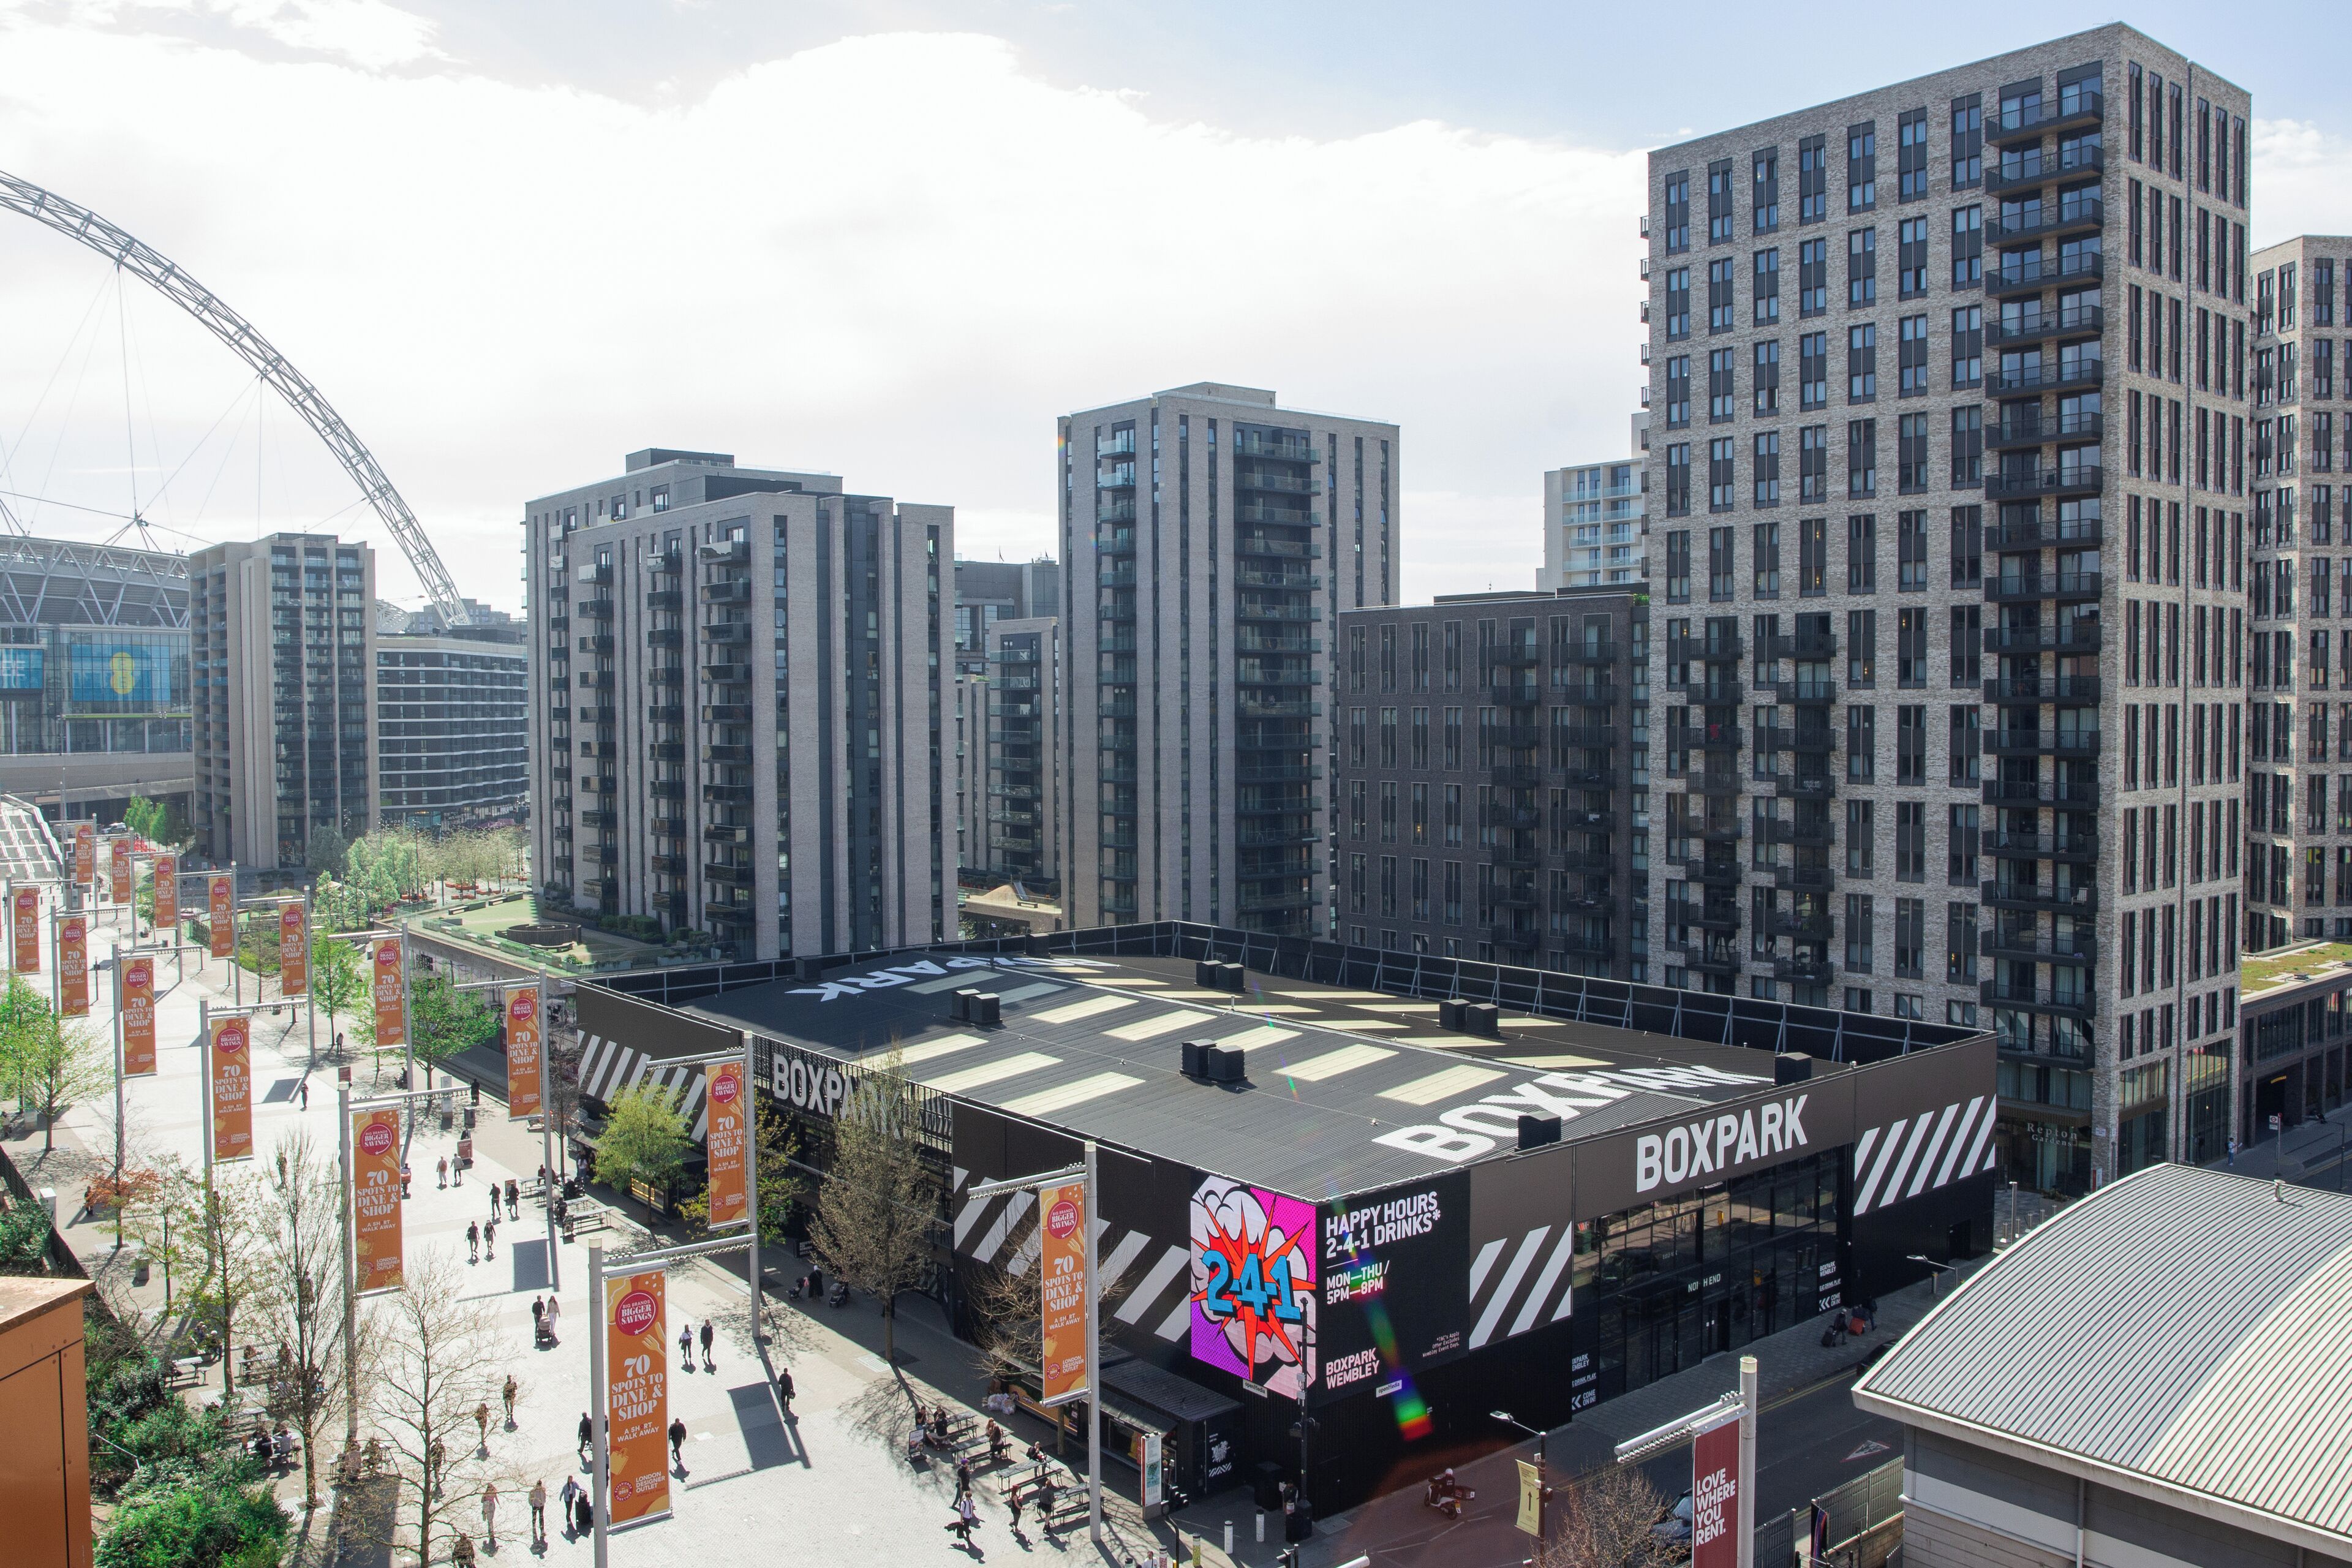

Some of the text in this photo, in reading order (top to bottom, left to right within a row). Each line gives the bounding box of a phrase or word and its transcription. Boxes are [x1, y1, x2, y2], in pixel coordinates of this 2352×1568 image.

[67, 951, 80, 959] 70
[382, 975, 394, 984] 70
[516, 1031, 530, 1042] 70
[510, 1049, 529, 1057] DINE
[513, 1055, 534, 1064] SHOP
[223, 1065, 240, 1077] 70
[216, 1084, 238, 1093] DINE
[219, 1091, 245, 1101] SHOP
[718, 1116, 734, 1131] 70
[710, 1131, 731, 1140] SPOTS
[2026, 1123, 2077, 1139] Repton
[710, 1136, 742, 1149] DINE &
[1637, 1094, 1808, 1193] BOXPARK
[2032, 1134, 2073, 1147] Gardens
[714, 1146, 739, 1158] SHOP
[367, 1170, 388, 1186] 70
[357, 1186, 385, 1196] SPOTS
[358, 1193, 398, 1207] DINE &
[363, 1204, 394, 1216] SHOP
[1326, 1191, 1438, 1238] HAPPY HOURS
[1052, 1212, 1074, 1223] BIGGER
[1052, 1219, 1075, 1229] SAVINGS
[1326, 1229, 1370, 1259] 2-4-1
[1054, 1256, 1074, 1275] 70
[1819, 1261, 1835, 1272] BOXPARK
[1819, 1266, 1836, 1277] WEMBLEY
[1046, 1271, 1083, 1288] SPOTS TO
[1202, 1250, 1301, 1320] 2-4-1
[1688, 1273, 1721, 1292] NOH END
[1046, 1281, 1083, 1300] DINE &
[1050, 1294, 1079, 1311] SHOP
[622, 1304, 651, 1317] BIGGER
[622, 1312, 652, 1324] SAVINGS
[1422, 1349, 1438, 1358] Wembley
[1572, 1353, 1588, 1365] XPARK
[624, 1354, 650, 1378] 70
[1063, 1355, 1081, 1365] LONDON
[1063, 1359, 1084, 1368] DESIGNER
[1326, 1348, 1376, 1376] BOXPARK
[1572, 1359, 1589, 1371] EMBLEY
[1326, 1360, 1380, 1390] WEMBLEY
[612, 1373, 663, 1393] SPOTS TO
[612, 1384, 663, 1408] DINE &
[1583, 1389, 1596, 1400] COME
[1583, 1398, 1589, 1406] ON
[619, 1400, 657, 1421] SHOP
[617, 1427, 658, 1442] WALK AWAY
[636, 1472, 661, 1482] LONDON
[636, 1476, 665, 1488] DESIGNER
[1697, 1468, 1726, 1496] LOVE
[636, 1483, 657, 1493] OUTLET
[1696, 1479, 1736, 1512] WHERE
[1696, 1503, 1721, 1529] YOU
[1696, 1518, 1726, 1547] RENT.
